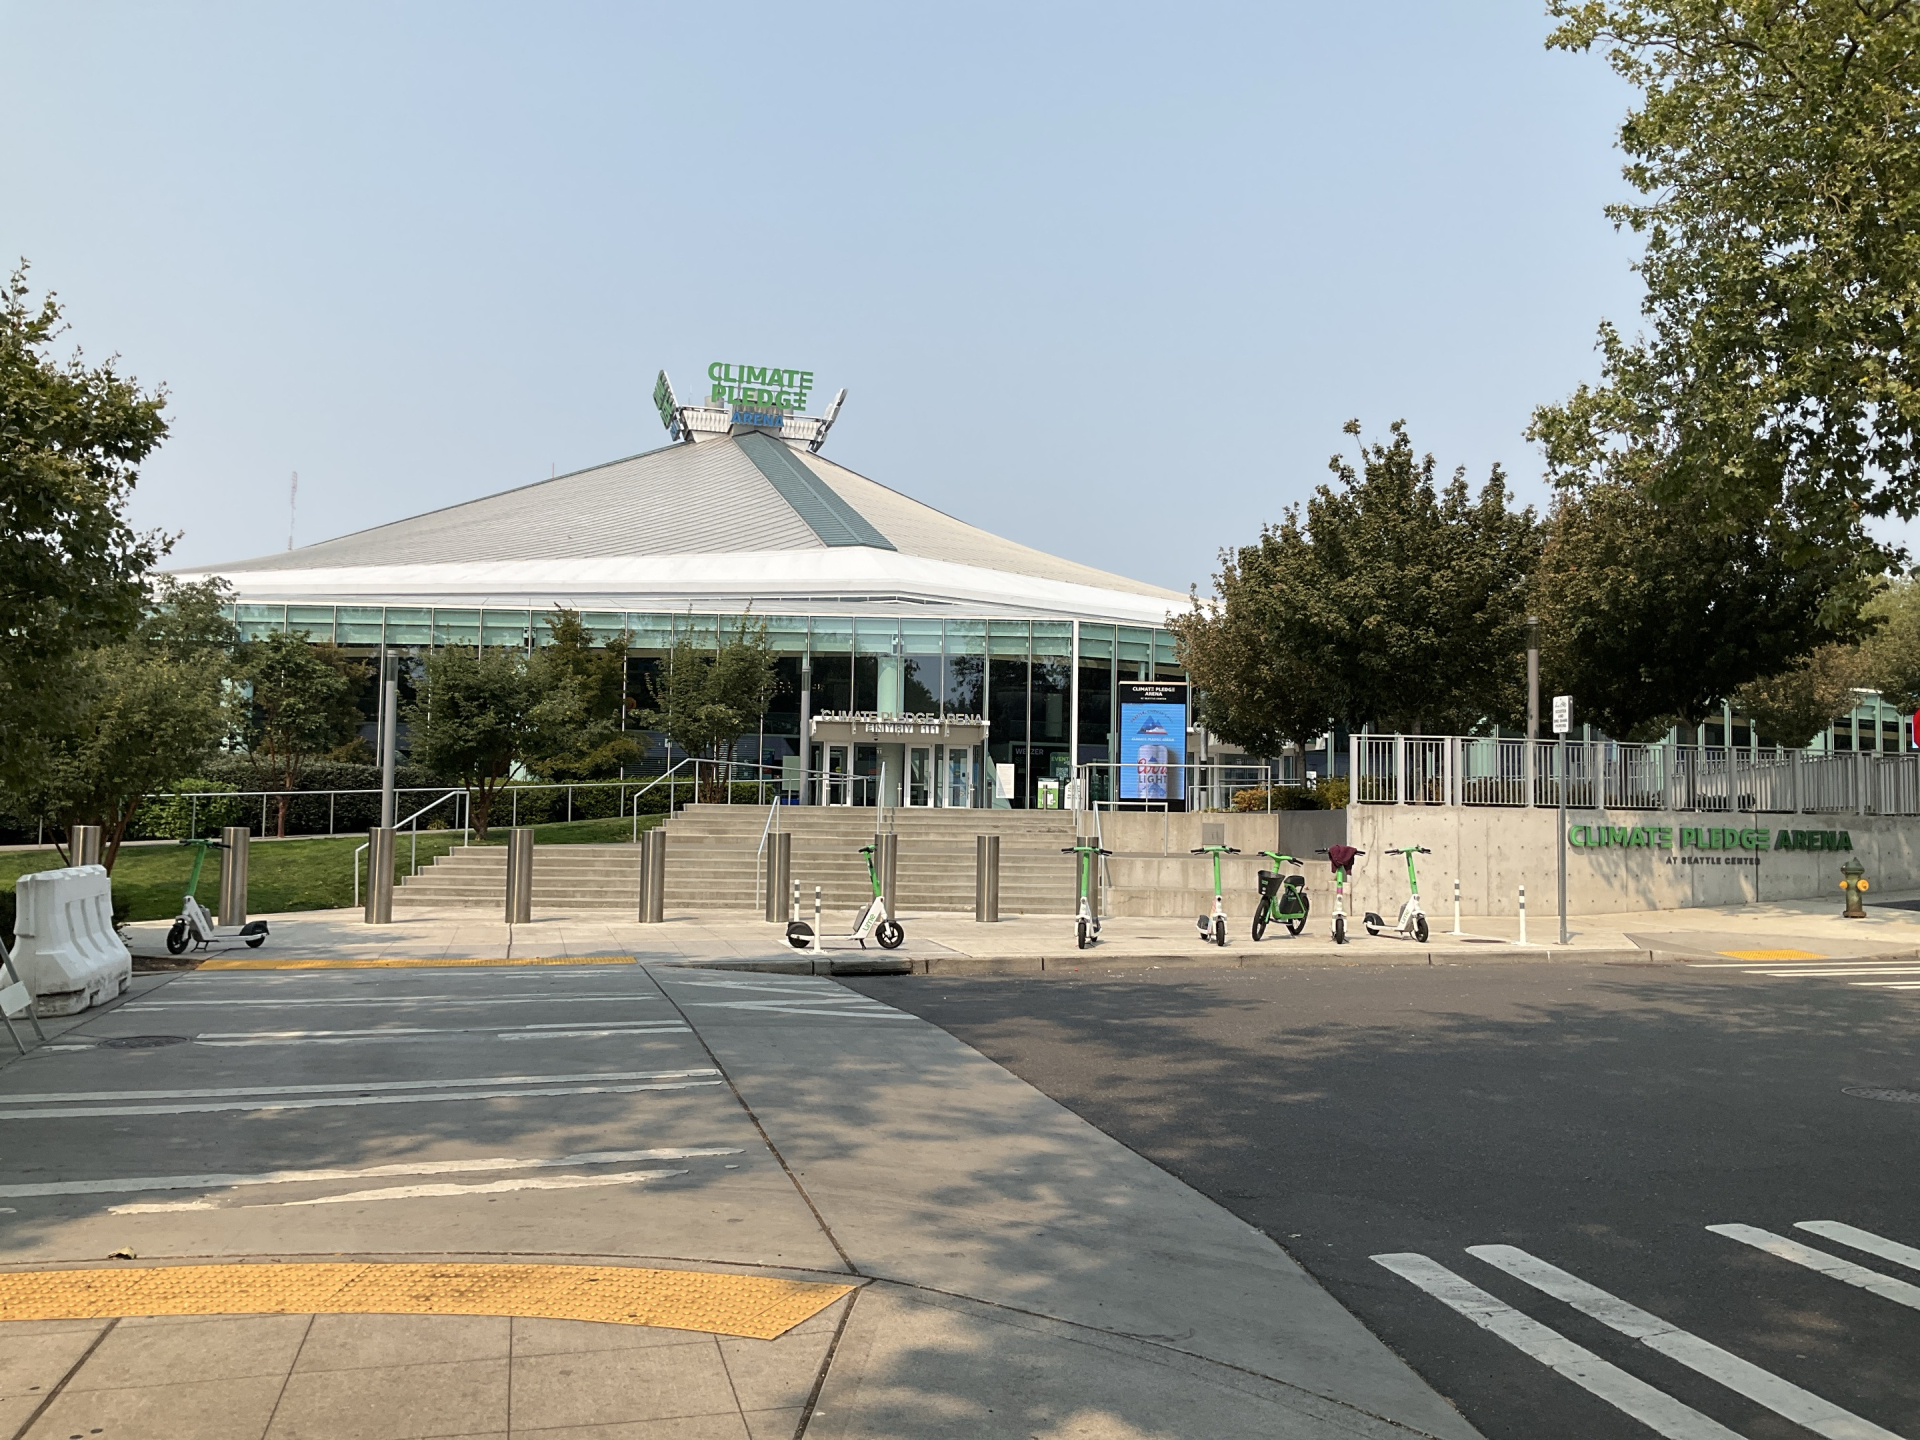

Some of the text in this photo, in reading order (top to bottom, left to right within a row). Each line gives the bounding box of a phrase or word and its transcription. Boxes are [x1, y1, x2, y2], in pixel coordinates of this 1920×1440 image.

[708, 361, 813, 391] CLIMATE
[711, 383, 807, 411] PLEDGE
[730, 410, 784, 428] ARENA
[821, 709, 983, 726] CLIMATE PLEDGE ARENA
[866, 723, 913, 733] ENTRY
[1138, 775, 1168, 783] LIGHT
[1568, 825, 1854, 851] CLIMATE PLEDGE ARENA
[1666, 857, 1678, 865] AT
[1681, 857, 1721, 865] SEATTLE
